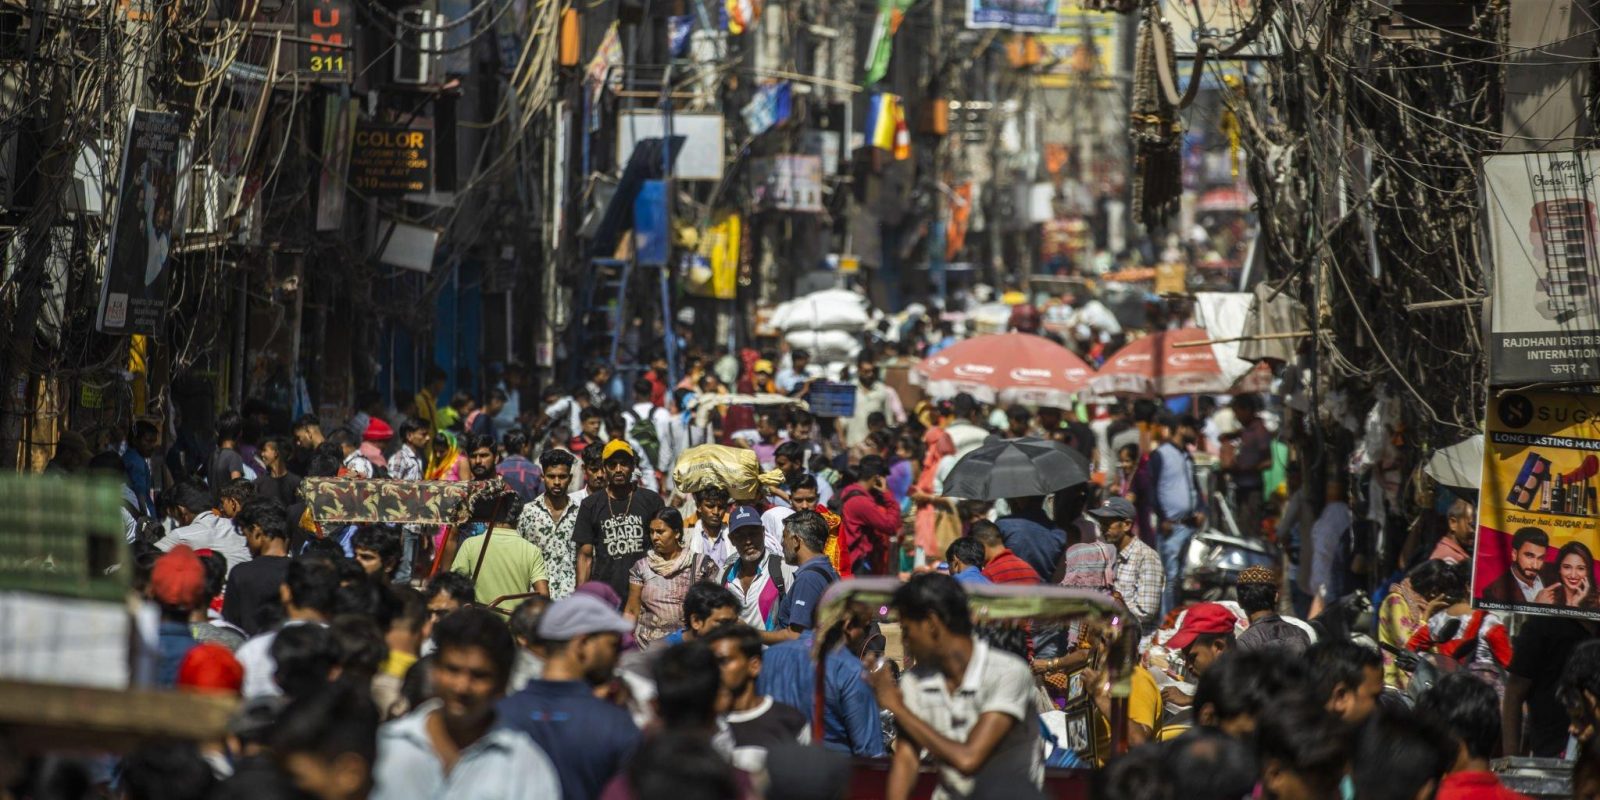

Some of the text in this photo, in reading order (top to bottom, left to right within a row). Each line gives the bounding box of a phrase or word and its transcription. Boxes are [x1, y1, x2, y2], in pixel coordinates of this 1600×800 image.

[310, 56, 343, 72] 311
[356, 131, 424, 149] COLOR
[355, 176, 379, 190] 310
[1503, 337, 1557, 348] RAJDHANI
[1527, 348, 1600, 360] INTERNATION
[1550, 363, 1576, 374] ऊपर
[1494, 433, 1600, 450] LONG LASTING MAK
[604, 525, 644, 542] HARD
[607, 538, 644, 556] CORE
[1479, 602, 1512, 610] RAJDHANI
[1513, 604, 1558, 615] DISTRIBUTORS
